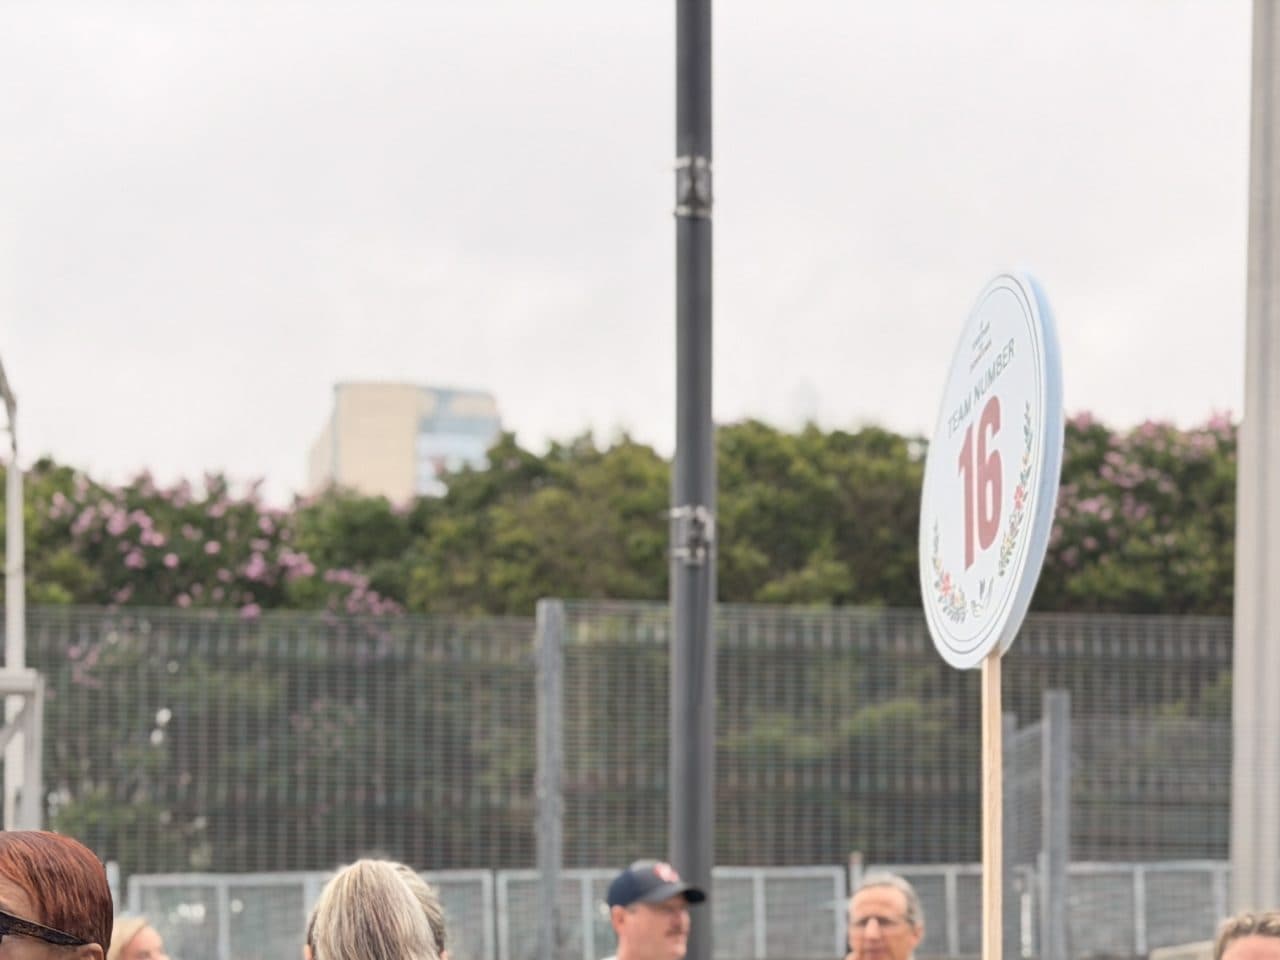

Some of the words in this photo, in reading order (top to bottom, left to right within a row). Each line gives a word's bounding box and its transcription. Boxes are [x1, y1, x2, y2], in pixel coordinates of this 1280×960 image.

[947, 391, 973, 440] TEAM
[973, 337, 1015, 406] NUMBER
[958, 395, 1002, 572] 16
